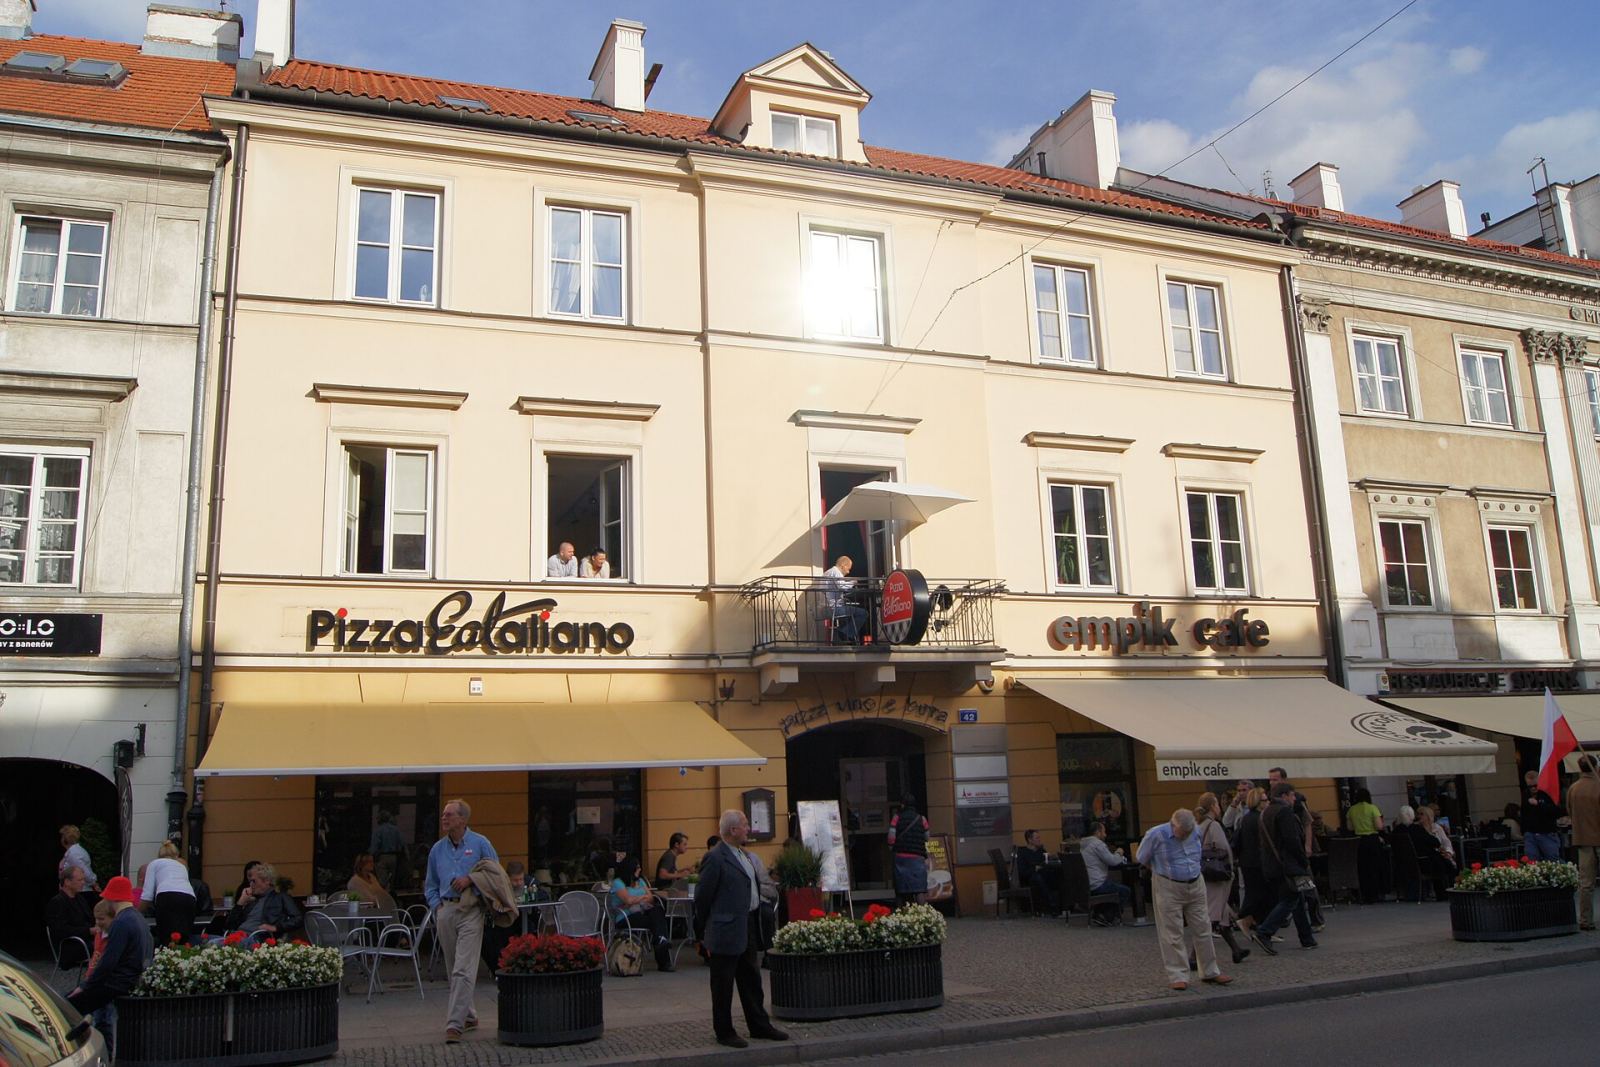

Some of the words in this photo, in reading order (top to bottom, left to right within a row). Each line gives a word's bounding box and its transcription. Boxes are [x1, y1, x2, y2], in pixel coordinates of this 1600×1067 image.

[308, 608, 424, 651] Pizza
[1048, 601, 1178, 654] empik
[1193, 608, 1269, 650] cafe
[962, 713, 975, 721] 42
[1163, 761, 1201, 778] empik
[1203, 763, 1229, 776] cafe
